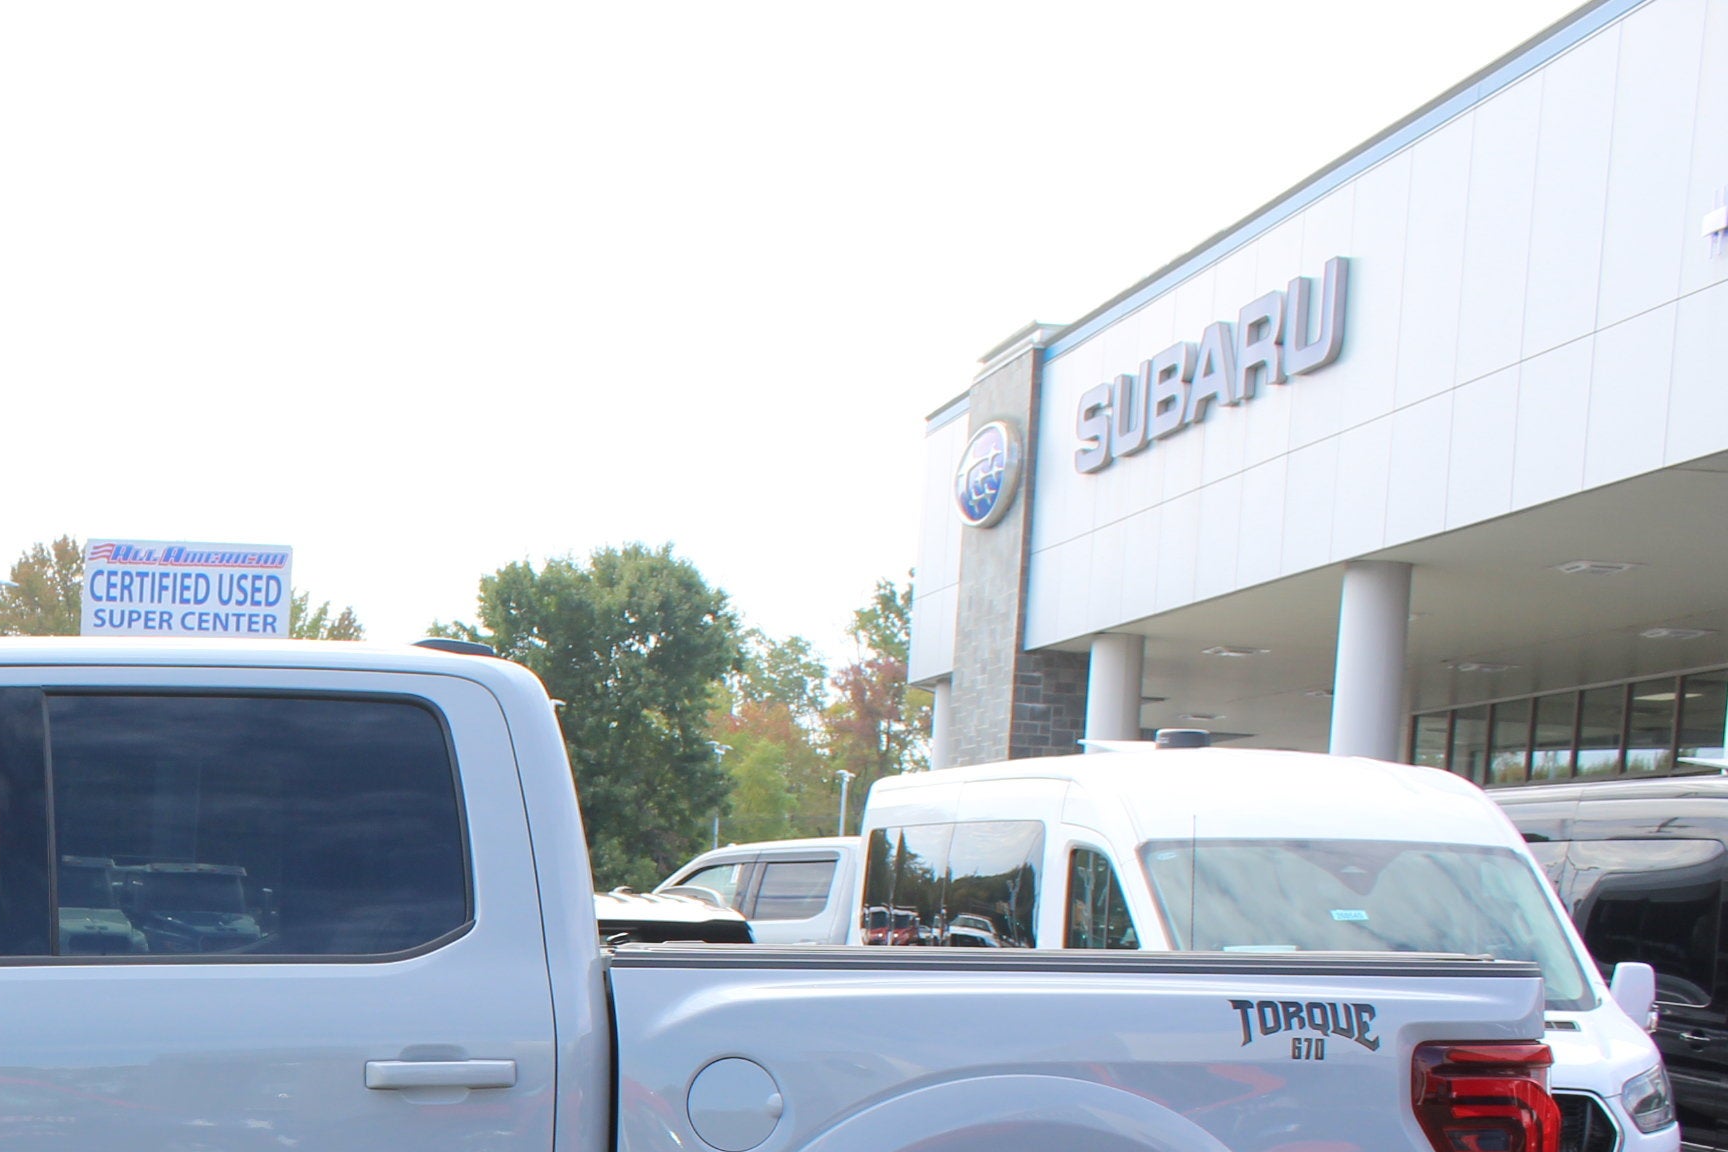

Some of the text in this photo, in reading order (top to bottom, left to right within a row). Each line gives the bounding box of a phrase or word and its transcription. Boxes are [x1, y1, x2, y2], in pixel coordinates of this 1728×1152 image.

[1075, 256, 1349, 474] SUBARU
[89, 569, 283, 608] CERTIFIED USED
[93, 608, 278, 634] SUPER CENTER
[1227, 999, 1381, 1051] TORQUE
[1291, 1037, 1325, 1060] 670
